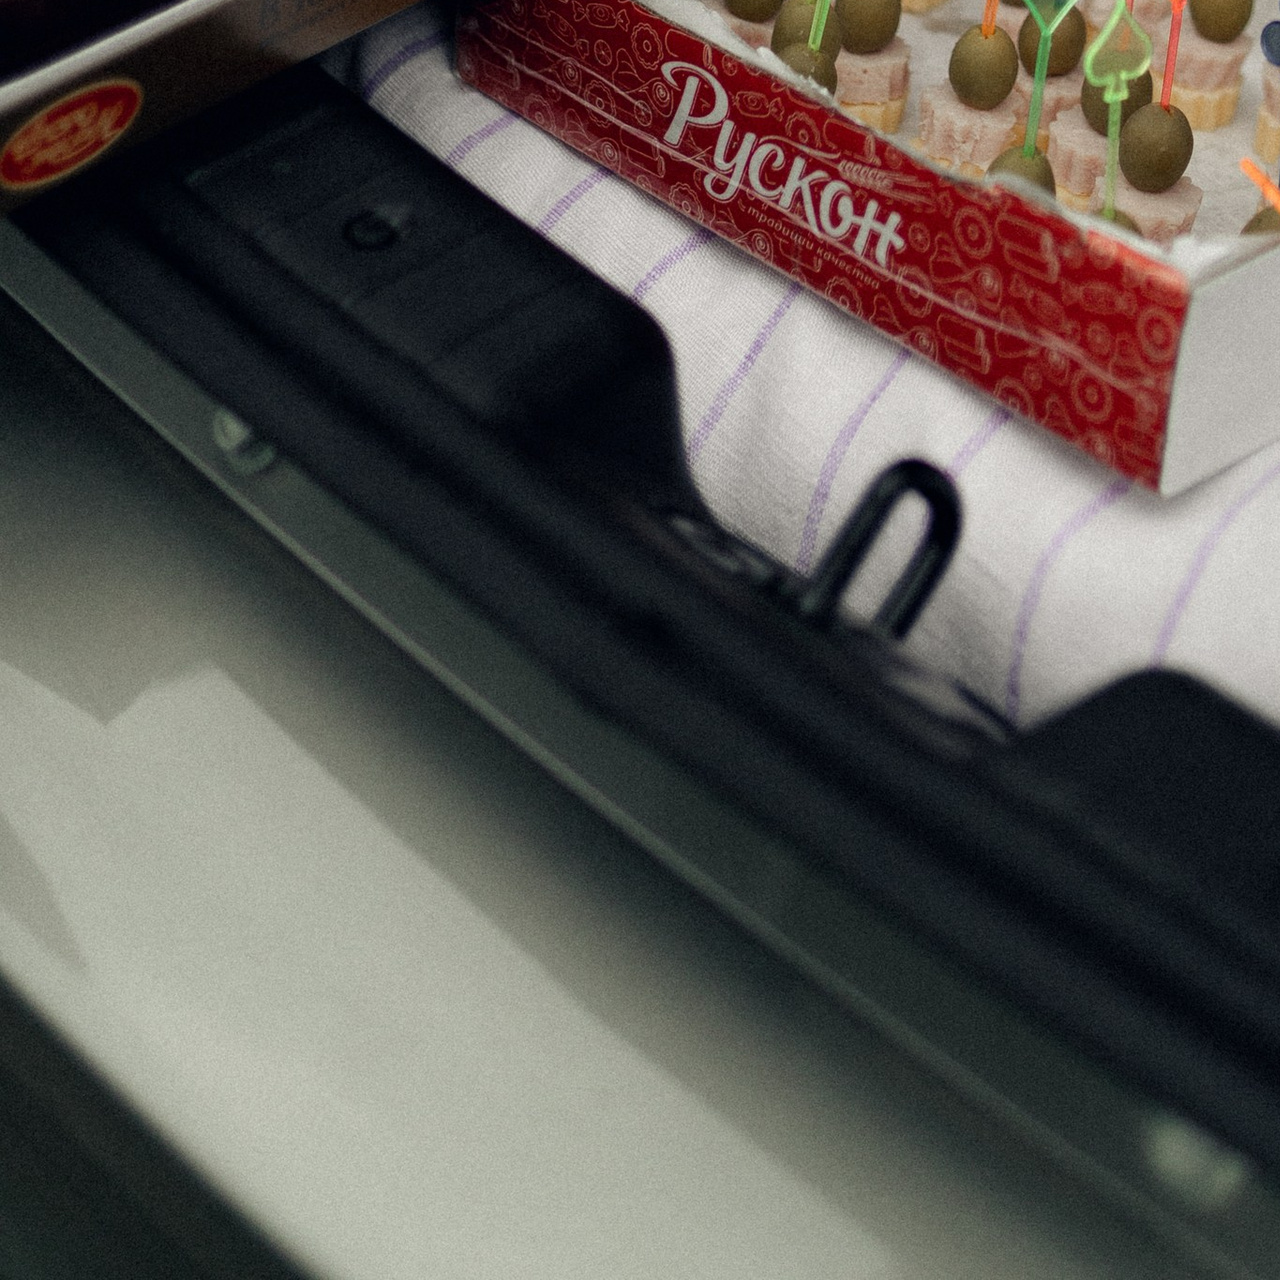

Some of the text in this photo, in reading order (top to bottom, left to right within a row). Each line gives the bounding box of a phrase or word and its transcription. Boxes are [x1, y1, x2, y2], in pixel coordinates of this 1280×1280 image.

[661, 61, 905, 267] Рускон
[746, 206, 881, 290] традиции качества
